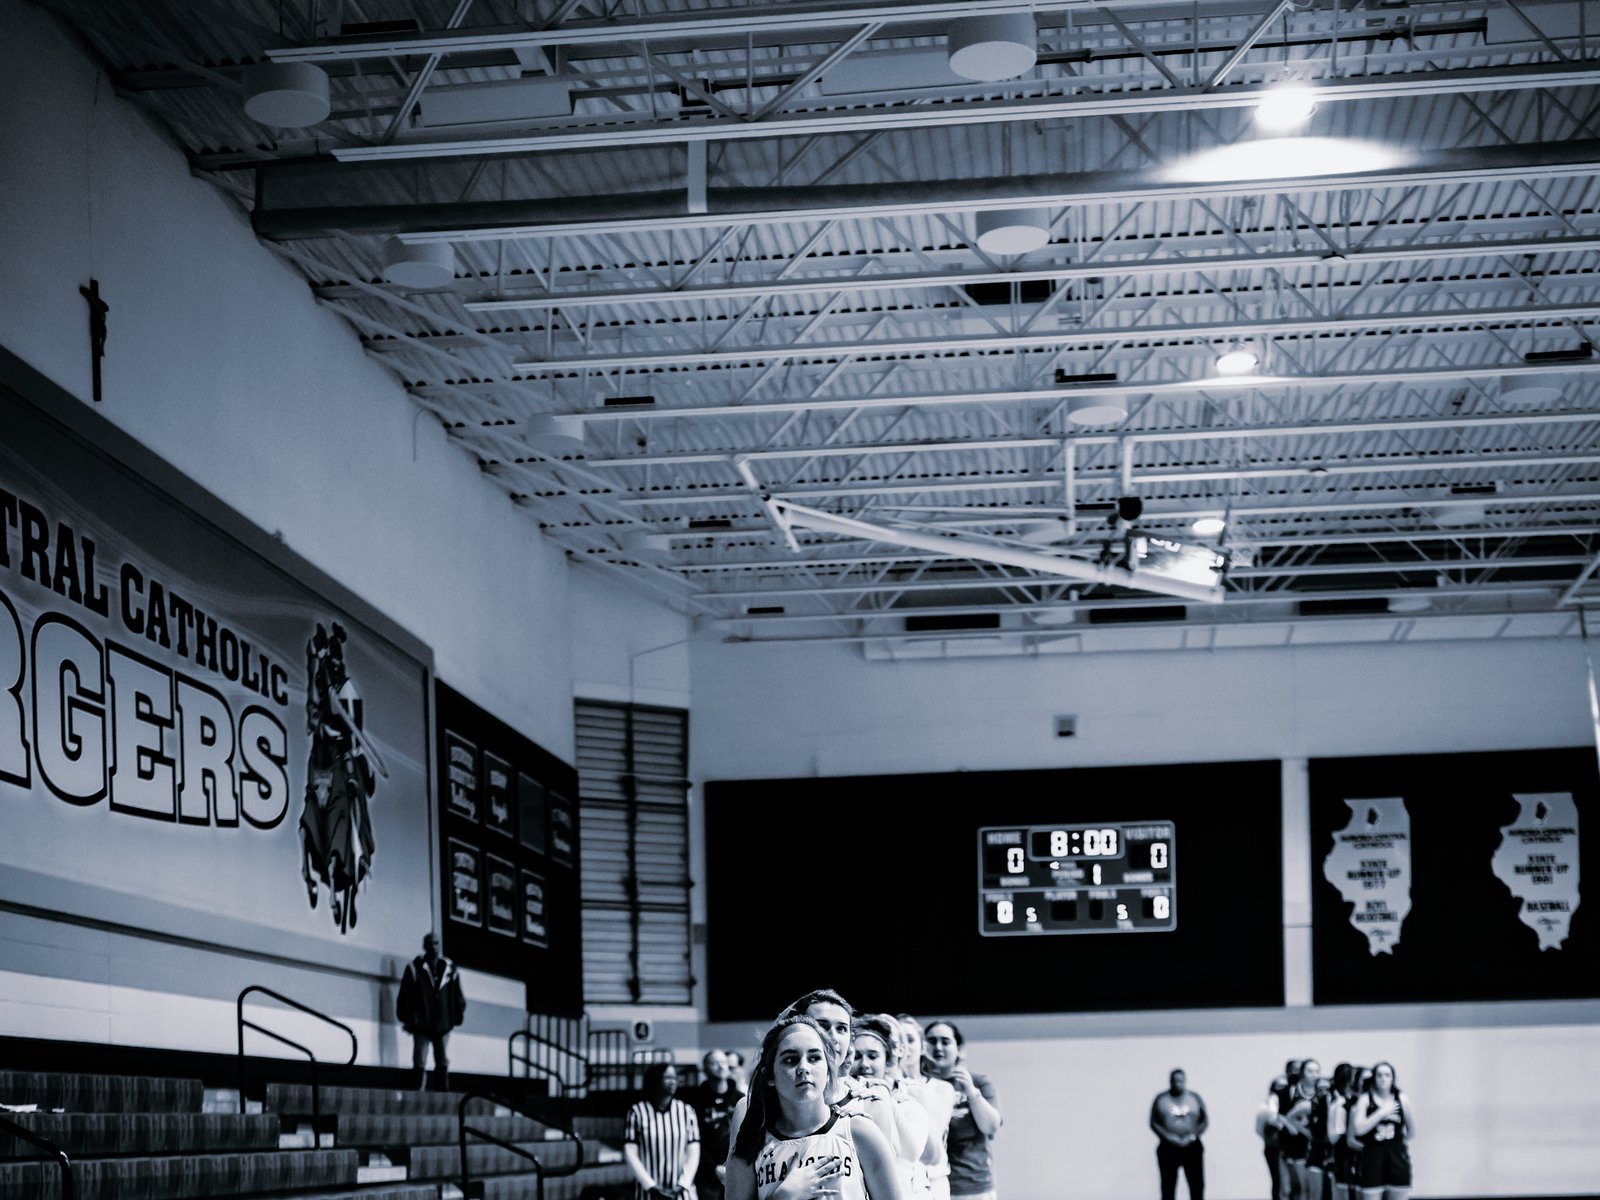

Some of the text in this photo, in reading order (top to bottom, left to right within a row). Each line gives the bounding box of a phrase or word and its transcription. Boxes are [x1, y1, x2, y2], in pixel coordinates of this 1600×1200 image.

[120, 563, 289, 706] CATHOLIC
[1050, 829, 1117, 857] 8:00
[1150, 842, 1168, 869] 0
[1007, 847, 1025, 874] 0
